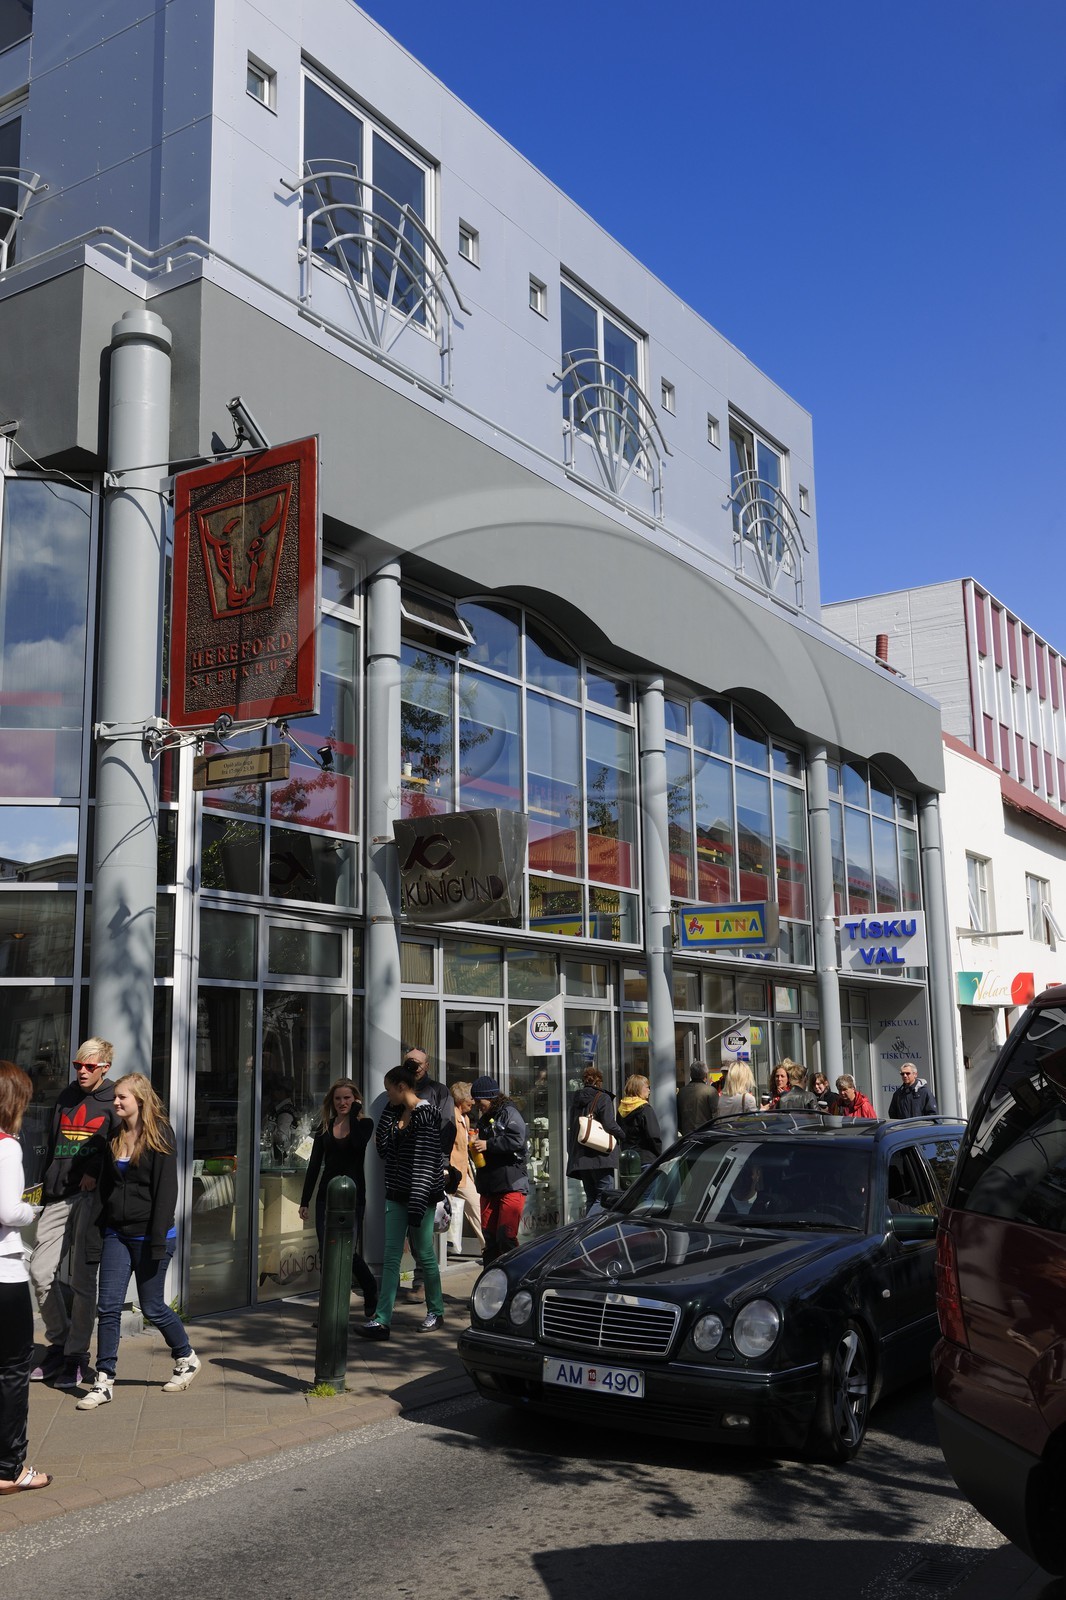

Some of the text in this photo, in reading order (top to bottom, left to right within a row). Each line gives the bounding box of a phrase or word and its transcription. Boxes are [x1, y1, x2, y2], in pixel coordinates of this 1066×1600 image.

[191, 631, 292, 668] HEREFORD
[405, 870, 504, 907] KÚNÍGÚND
[715, 917, 759, 933] IANA
[845, 918, 917, 940] TÍSKU
[859, 946, 906, 965] VAL
[879, 1018, 920, 1027] TÍSKUVAL
[880, 1051, 922, 1060] TÍSKUVAL
[556, 1364, 639, 1393] AM 10 490
